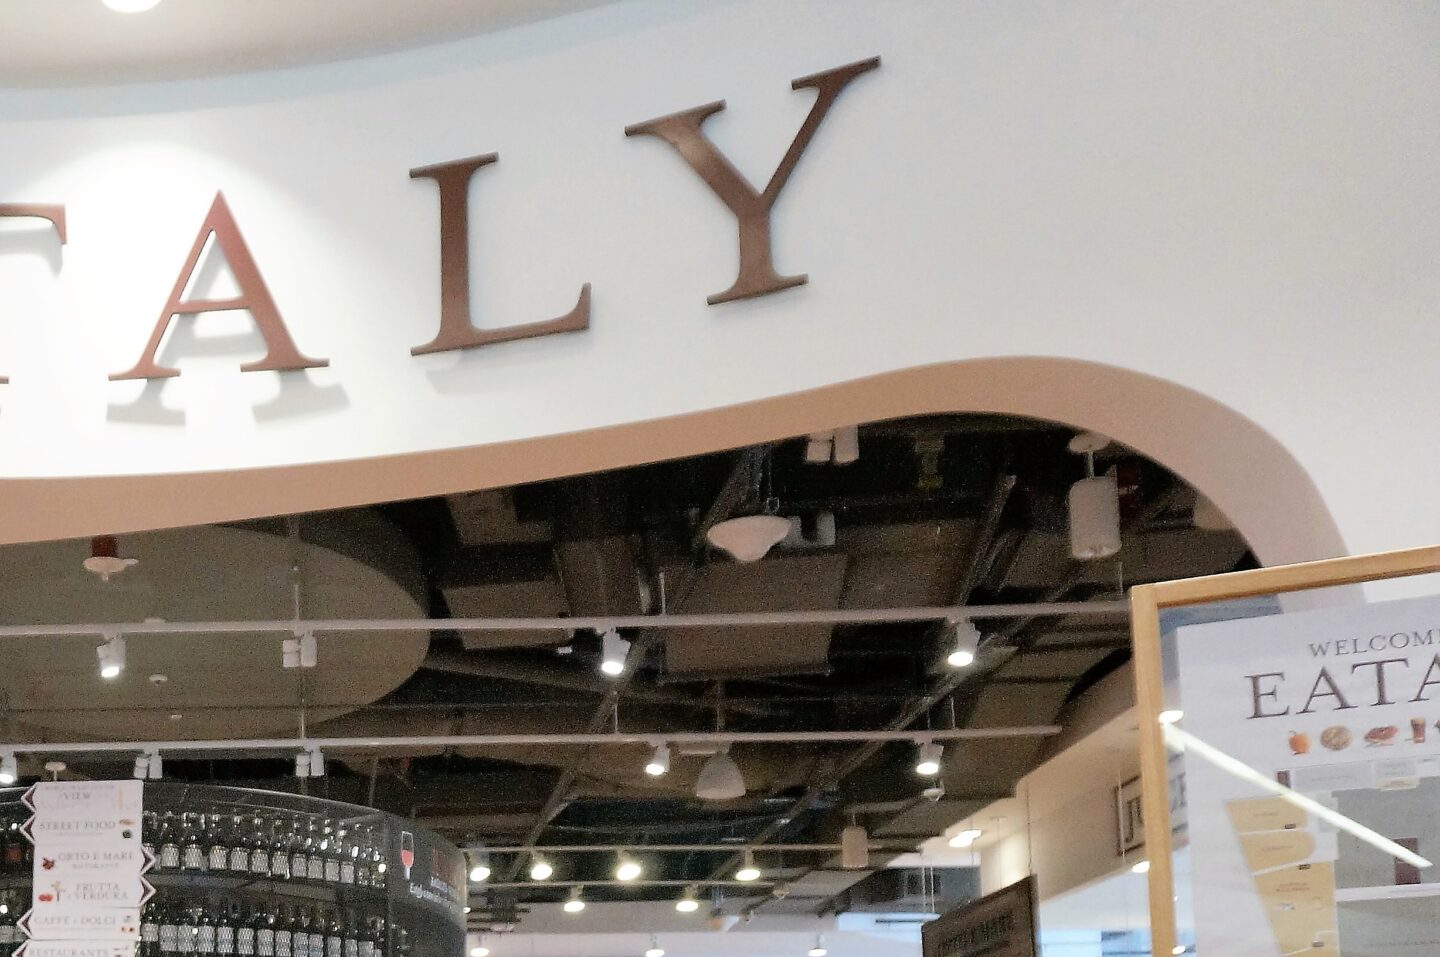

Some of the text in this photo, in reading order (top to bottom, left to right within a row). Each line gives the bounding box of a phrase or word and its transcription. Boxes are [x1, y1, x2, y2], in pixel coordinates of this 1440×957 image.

[39, 820, 117, 831] STREET FOOD
[76, 883, 121, 891] FRUTTA
[80, 915, 117, 926] DOLCI
